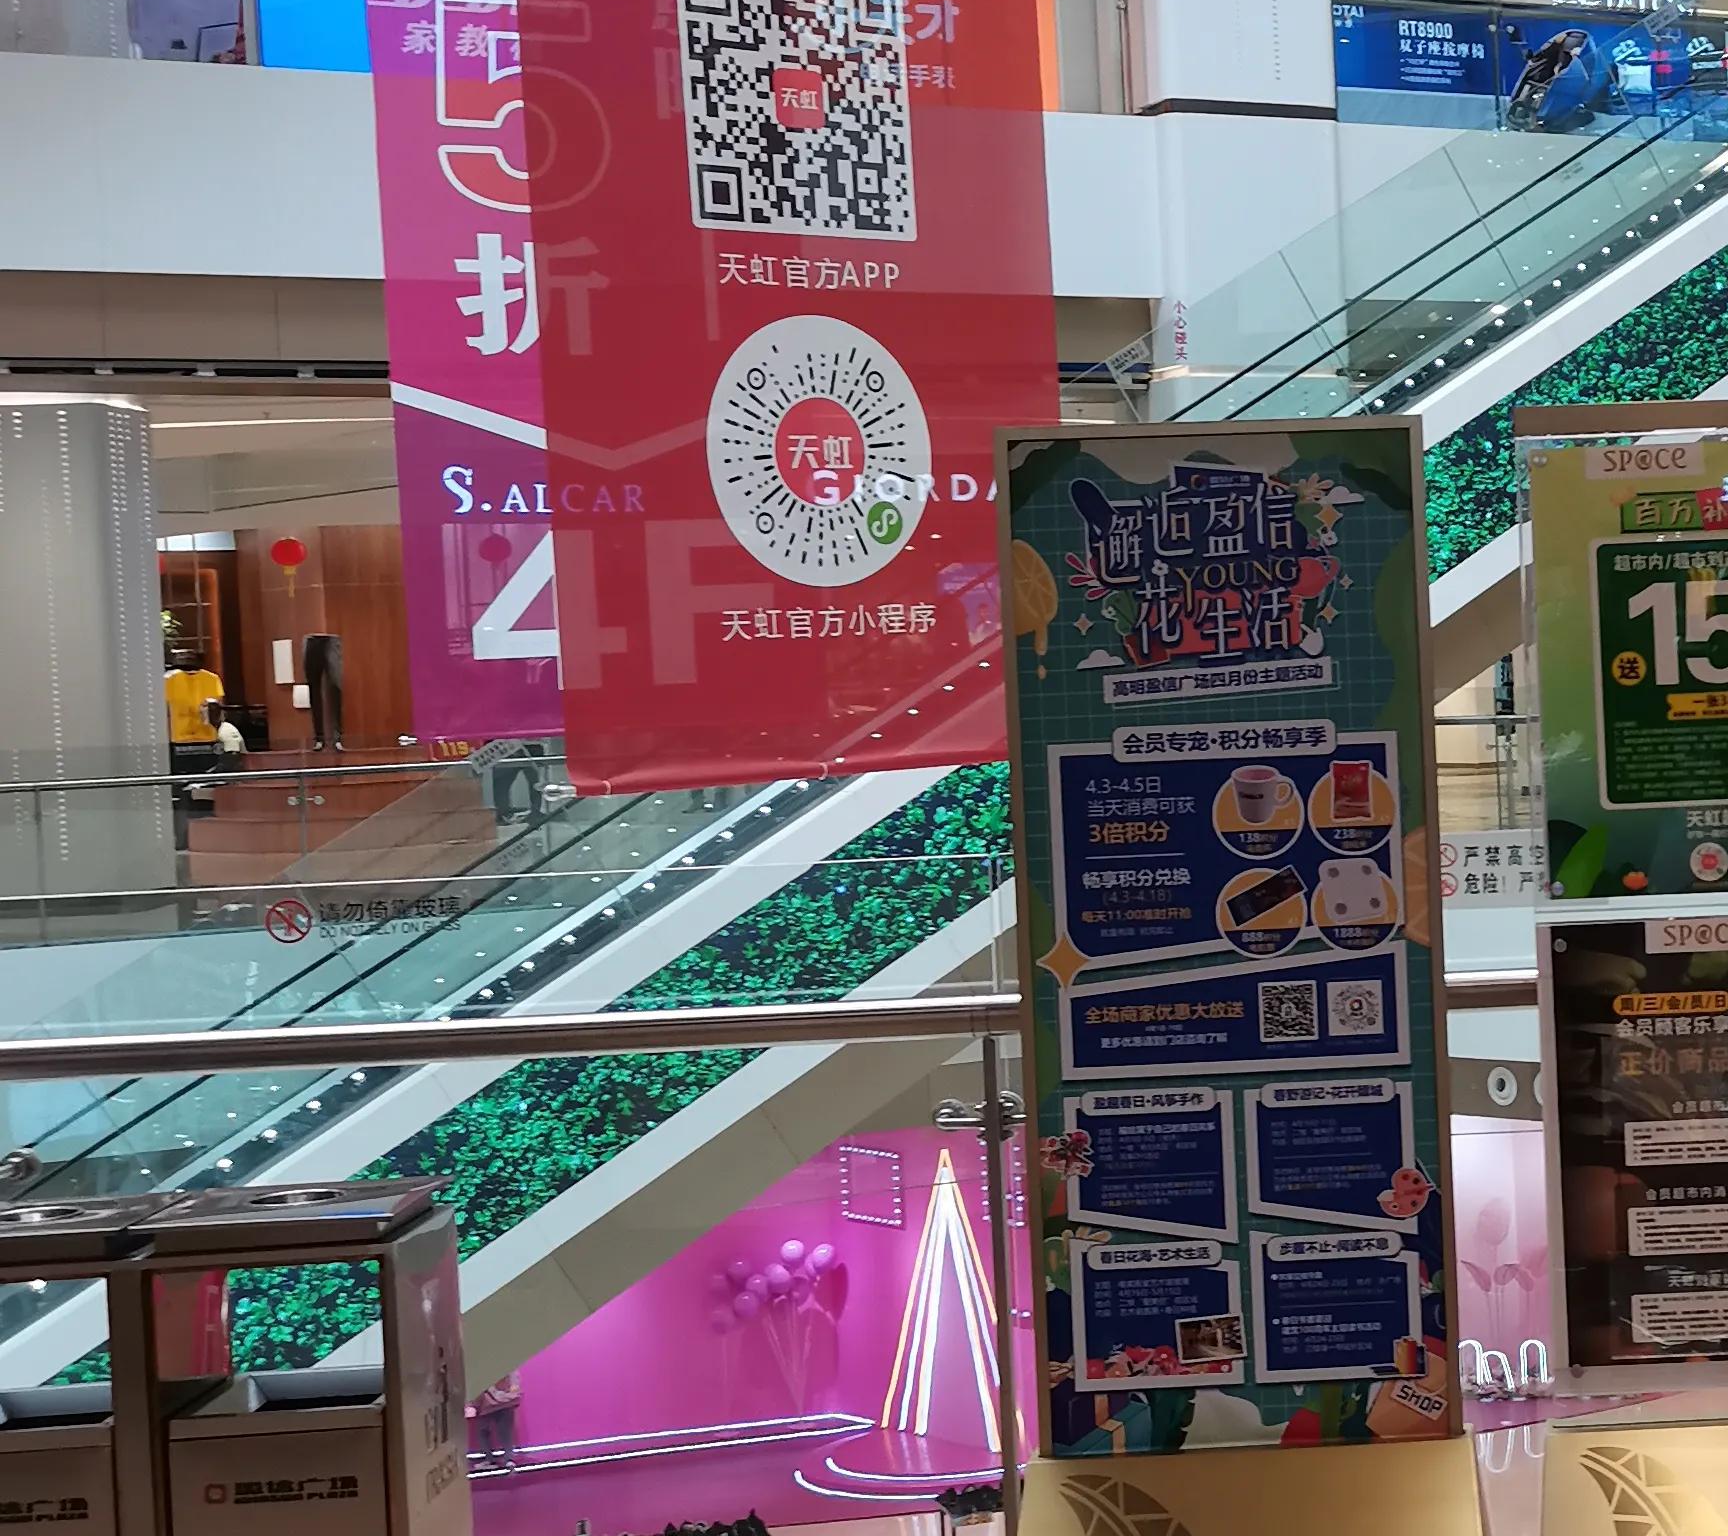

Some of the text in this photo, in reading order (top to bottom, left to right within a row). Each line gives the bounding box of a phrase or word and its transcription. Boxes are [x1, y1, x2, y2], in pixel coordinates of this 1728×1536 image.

[402, 21, 520, 61] 家教
[1398, 20, 1454, 40] RT8900
[1399, 39, 1486, 59] 双子座按摩椅
[781, 88, 818, 110] 天虹
[718, 253, 900, 291] 天虹官方APP
[787, 434, 854, 470] 天虹
[1091, 480, 1295, 583] 邂逅盈信
[1176, 556, 1298, 615] YOUNG
[720, 602, 937, 643] 天虹官方小程序
[1136, 562, 1292, 660] 花生活
[1112, 664, 1323, 697] 高明盈信广场四月份主题活动
[1616, 657, 1641, 680] 送
[1122, 726, 1328, 753] 会员专宠·积分畅享季
[1086, 776, 1162, 794] 4.3-4.5日
[1086, 797, 1197, 818] 当天消费可获
[1088, 822, 1171, 844] 3倍积分
[1395, 1384, 1444, 1414] SHOP
